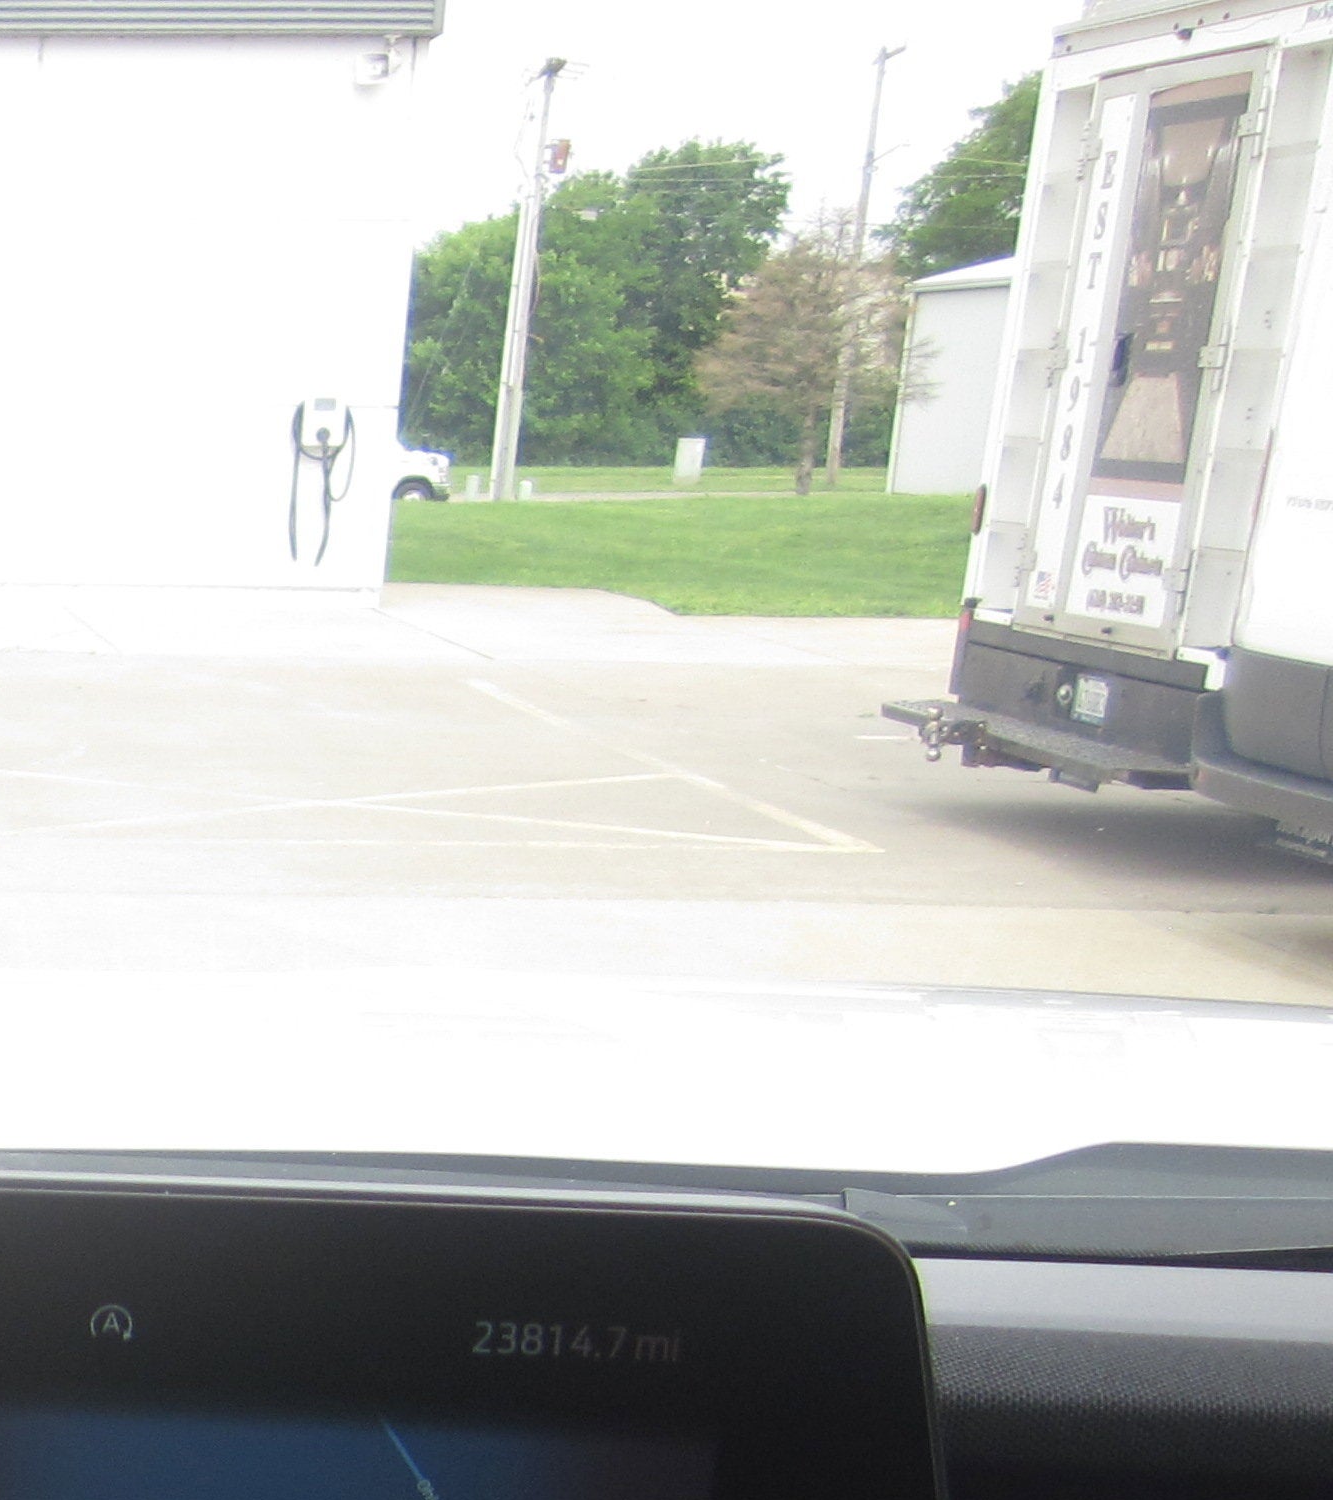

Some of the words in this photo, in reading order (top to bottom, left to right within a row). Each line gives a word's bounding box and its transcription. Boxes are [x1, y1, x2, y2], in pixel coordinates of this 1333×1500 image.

[1087, 151, 1117, 289] EST
[1052, 327, 1088, 511] 1984
[471, 1320, 629, 1360] 23814.7
